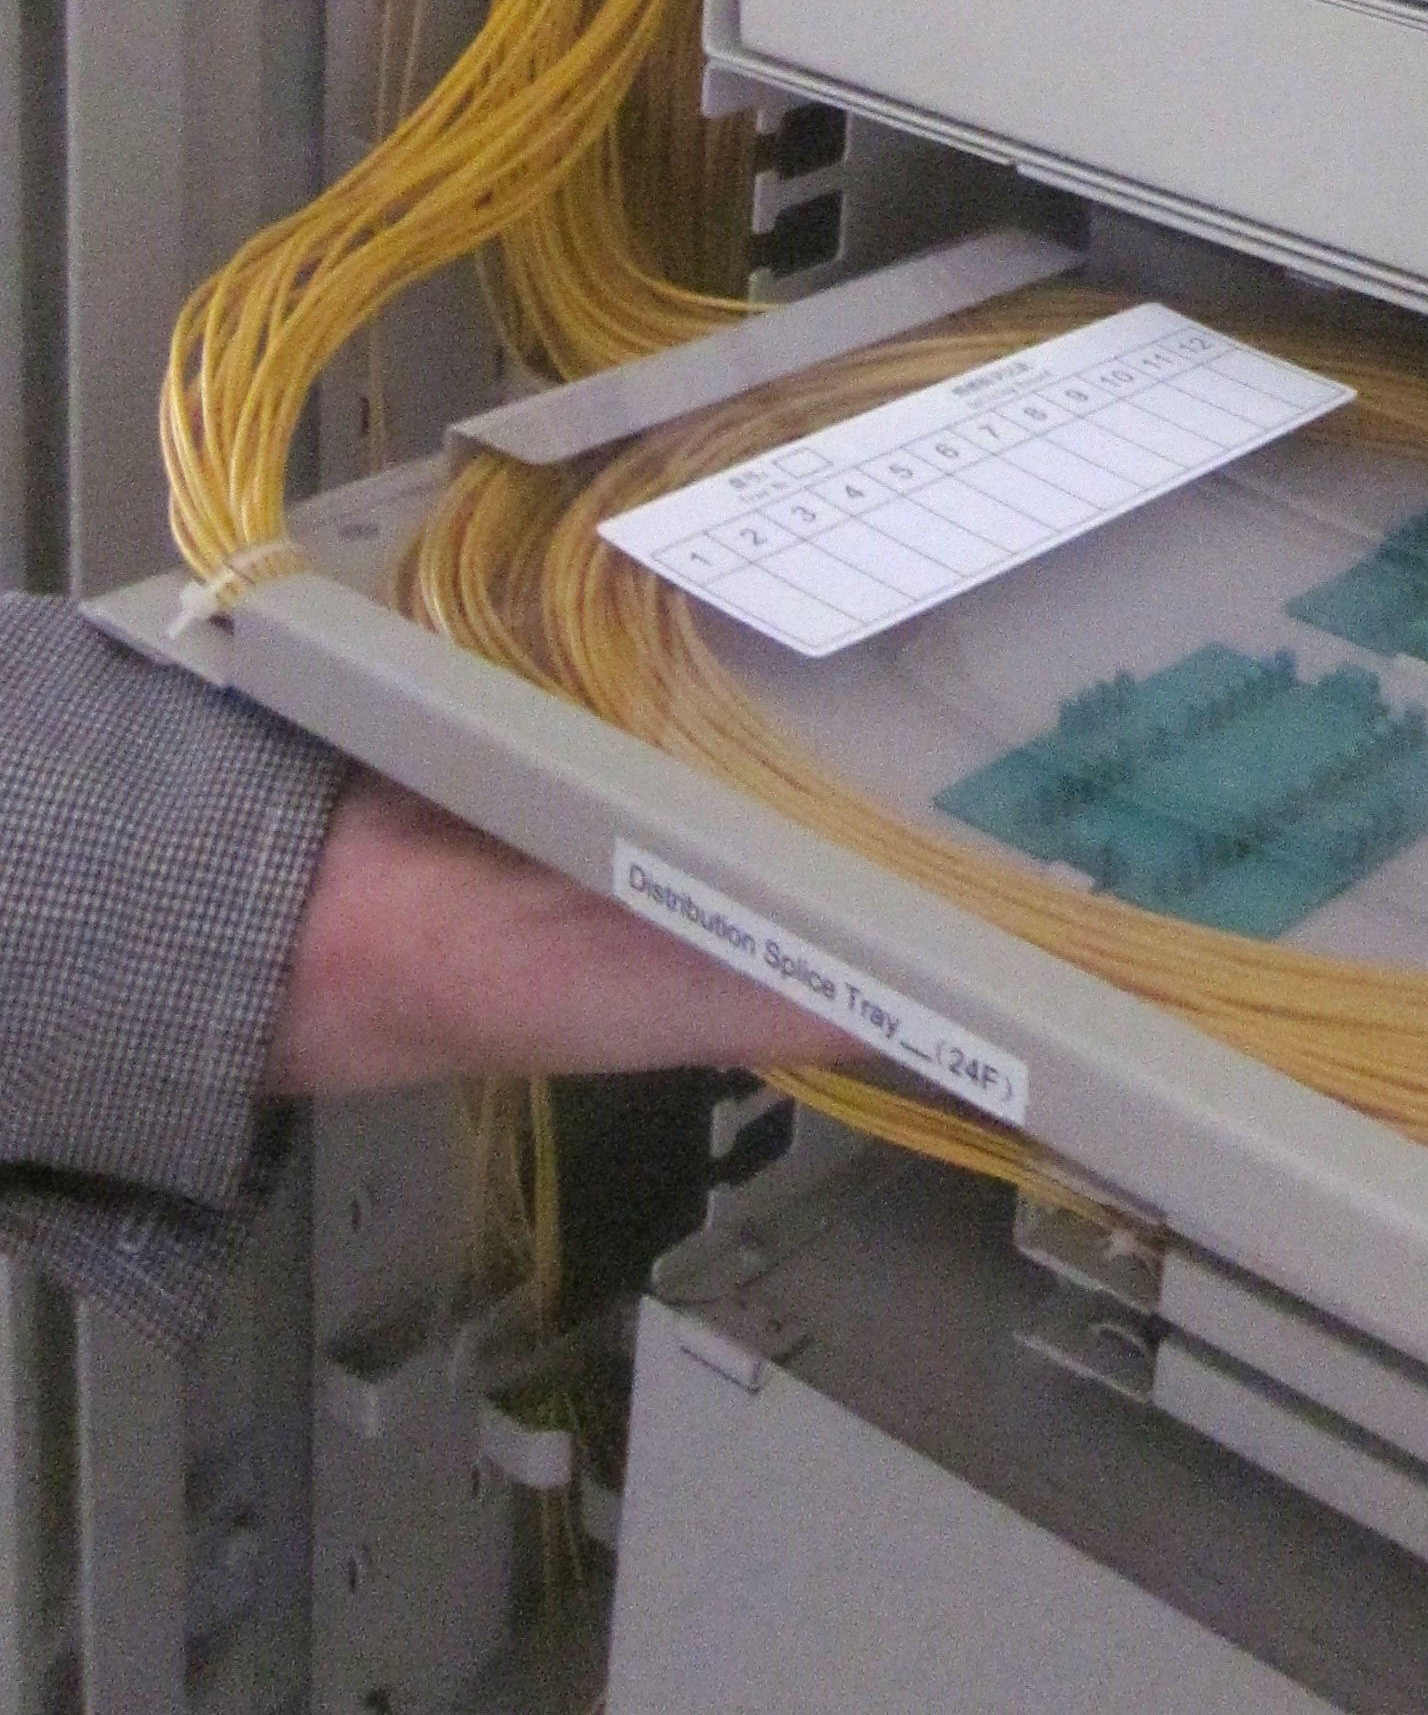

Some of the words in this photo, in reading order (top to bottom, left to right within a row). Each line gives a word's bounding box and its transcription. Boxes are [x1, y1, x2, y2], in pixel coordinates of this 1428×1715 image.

[690, 551, 713, 567] 1
[740, 528, 767, 546] 2
[791, 506, 817, 523] 3
[845, 485, 865, 498] 4
[889, 462, 913, 479] 5
[935, 443, 959, 459] 6
[977, 423, 1000, 438] 7
[1023, 406, 1048, 421] 8
[1065, 389, 1088, 402] 9
[1100, 368, 1134, 385] 10
[1142, 353, 1172, 369] 11
[1179, 336, 1212, 354] 12
[628, 863, 756, 957] Distribution
[764, 940, 836, 1003] Splice
